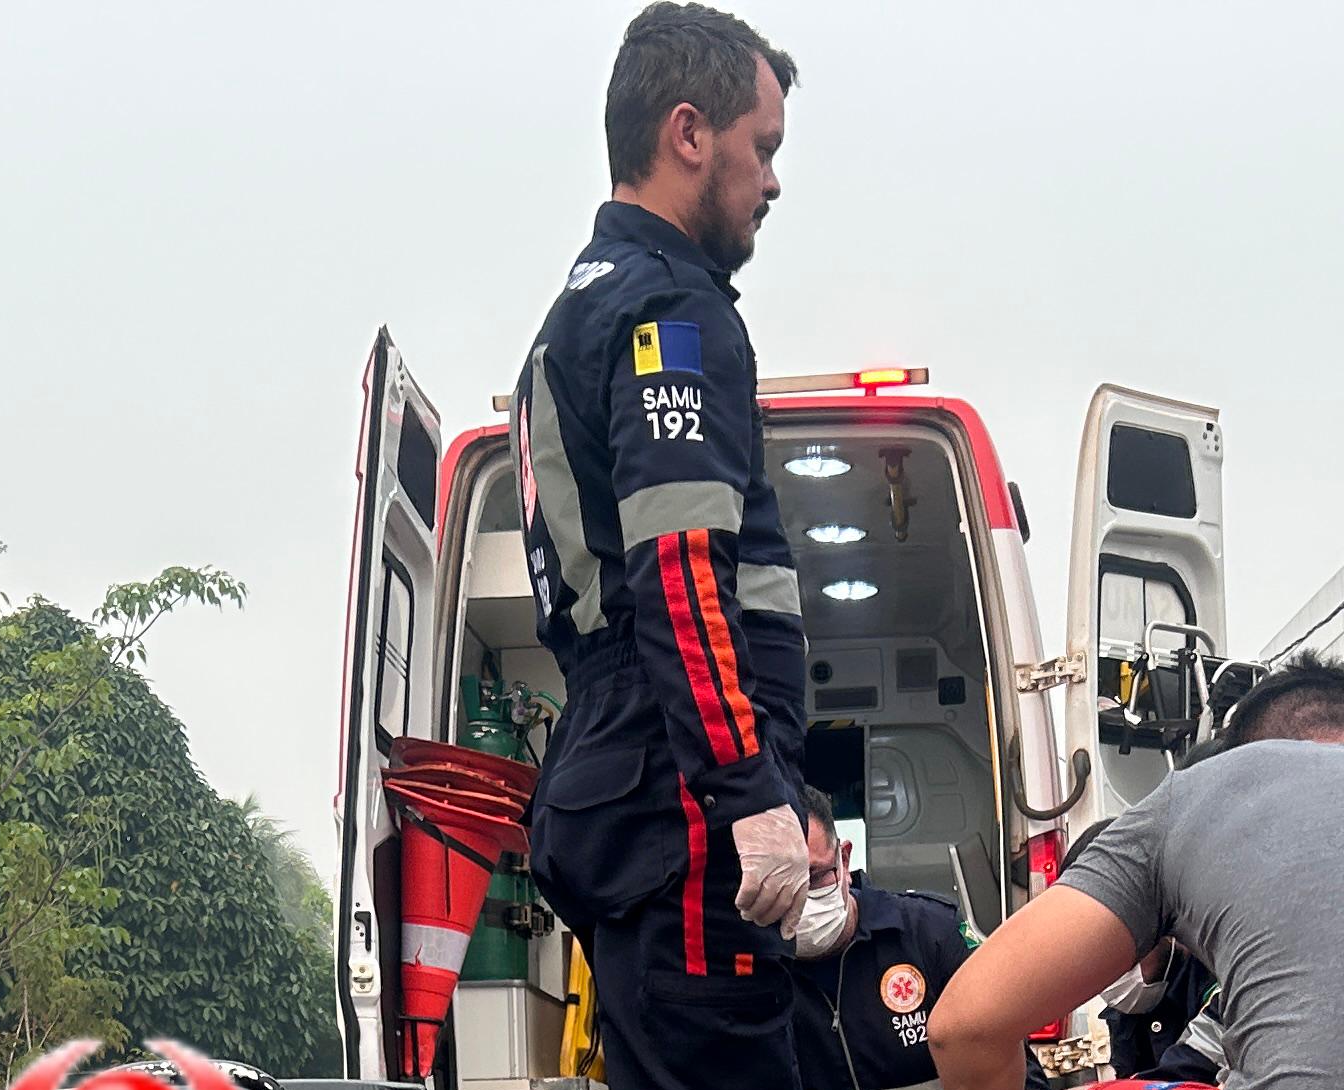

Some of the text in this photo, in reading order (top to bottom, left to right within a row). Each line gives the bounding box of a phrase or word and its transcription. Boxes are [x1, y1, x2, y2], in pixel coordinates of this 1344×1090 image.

[642, 385, 702, 411] SAMU
[646, 410, 704, 442] 192
[891, 1010, 927, 1030] SAMU
[898, 1025, 928, 1048] 192
